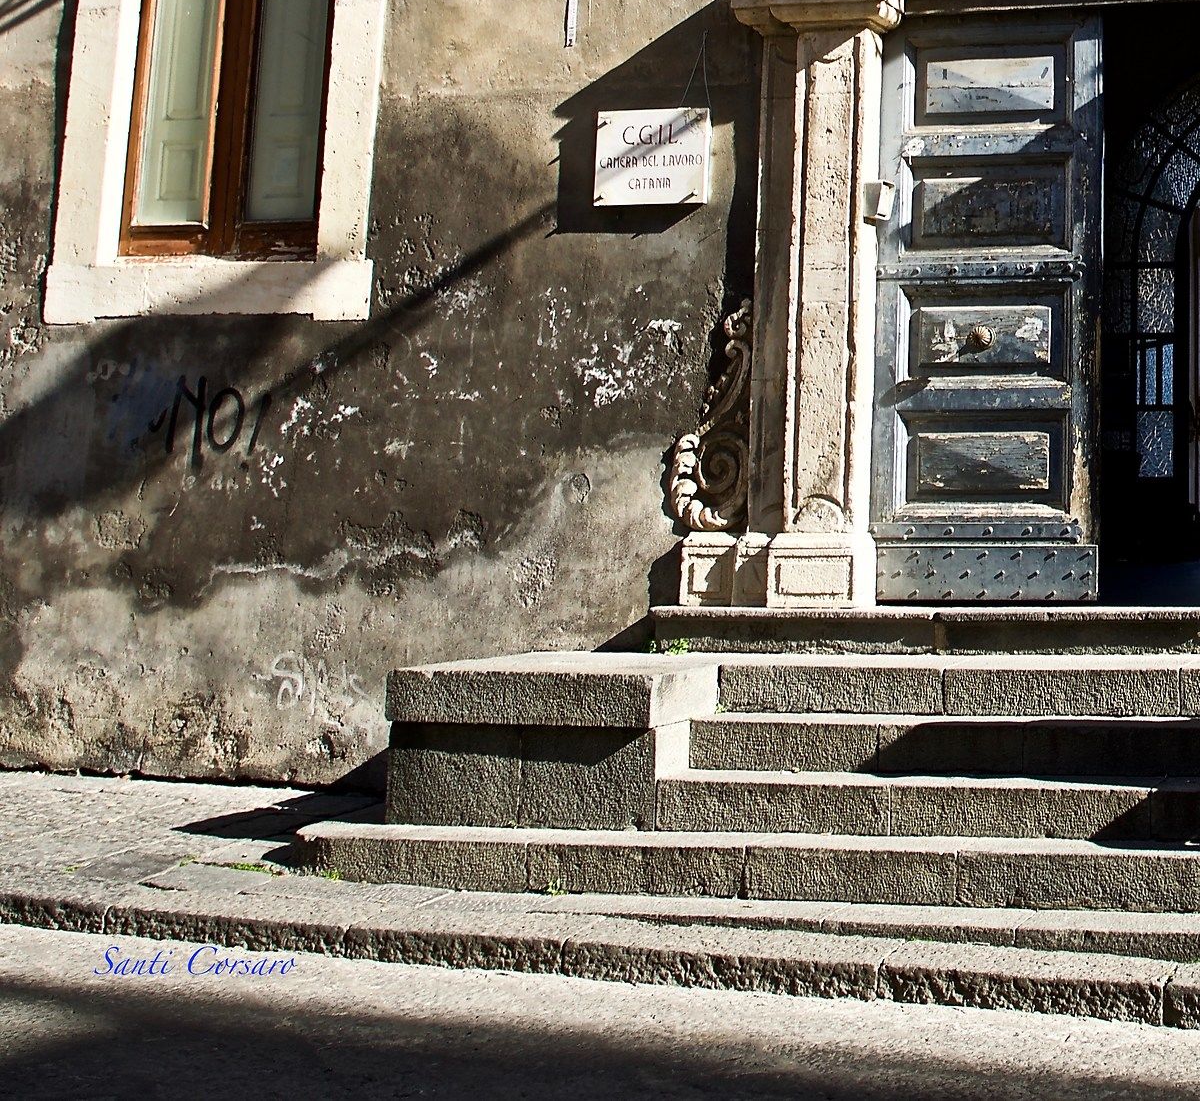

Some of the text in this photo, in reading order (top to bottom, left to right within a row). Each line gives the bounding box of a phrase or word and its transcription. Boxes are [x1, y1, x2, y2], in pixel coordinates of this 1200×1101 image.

[622, 124, 683, 146] C.G.I.L.
[600, 154, 703, 169] CAMERA DEL LAVORO
[628, 178, 671, 190] CATANIA
